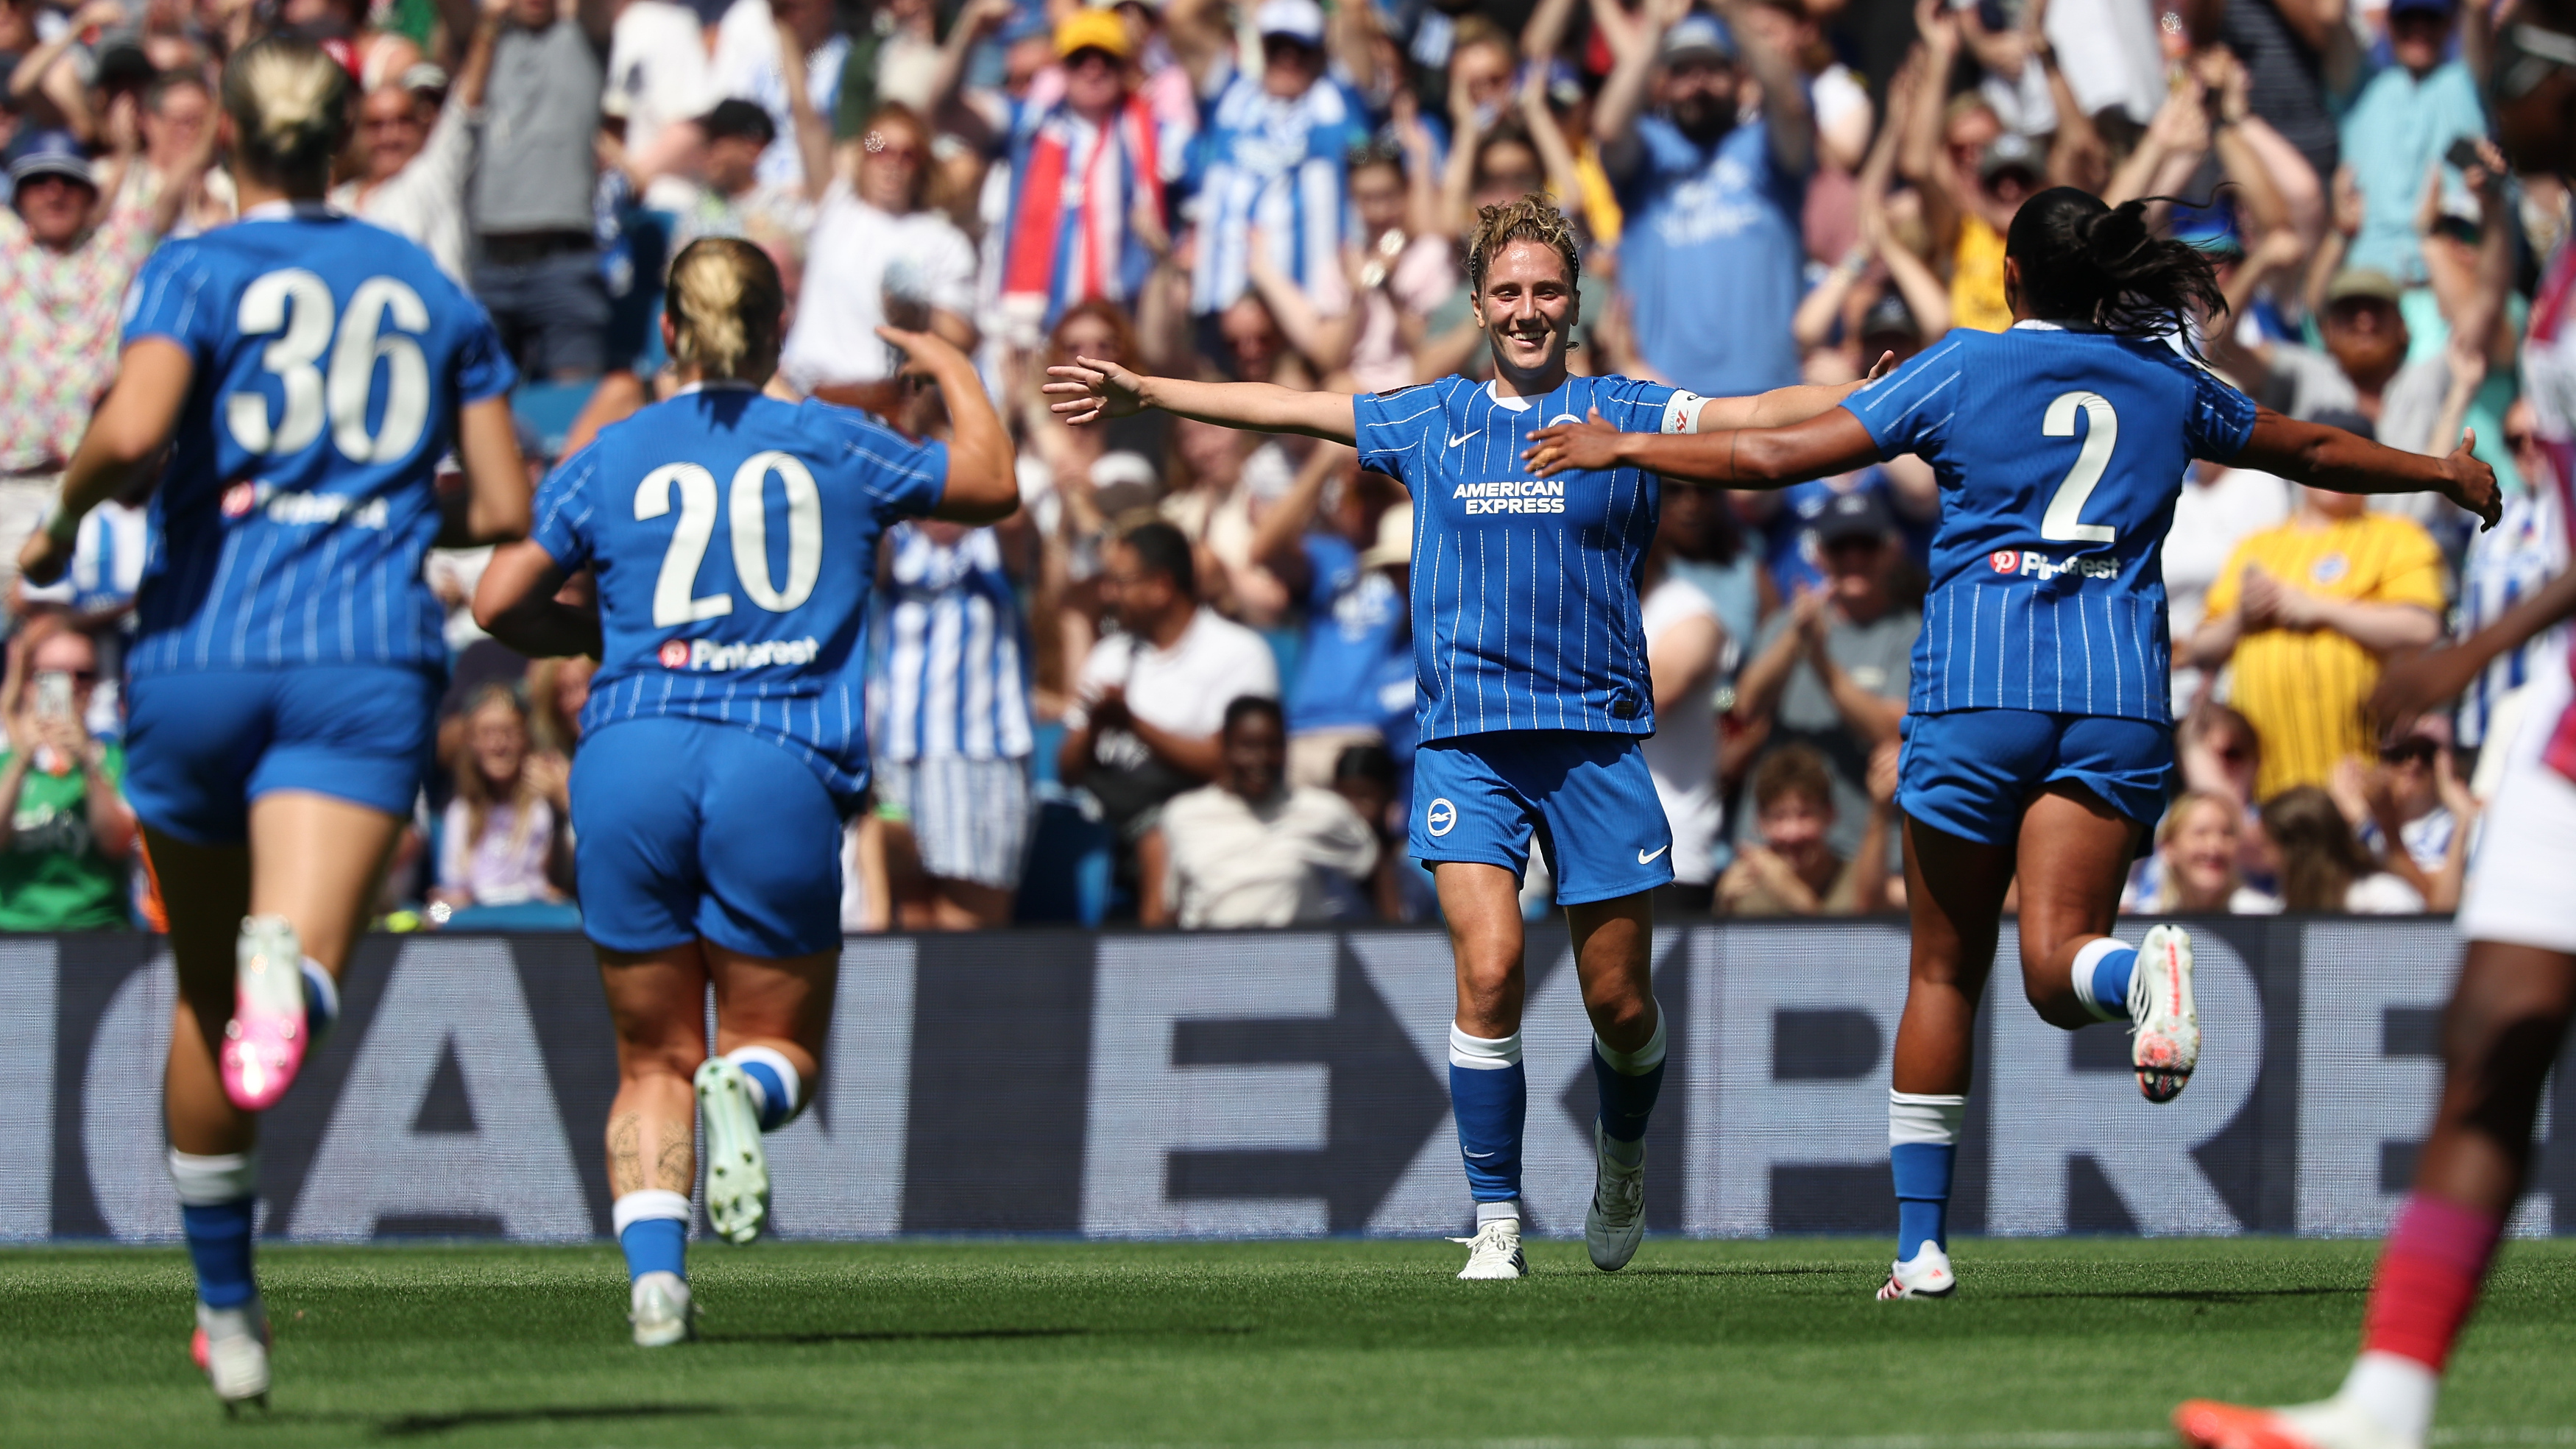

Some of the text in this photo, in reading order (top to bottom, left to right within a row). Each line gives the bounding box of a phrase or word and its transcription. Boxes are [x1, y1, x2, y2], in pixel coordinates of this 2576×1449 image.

[226, 267, 431, 466] 36
[1676, 409, 1689, 434] SL
[1453, 481, 1564, 499] AMERICAN
[1466, 498, 1565, 514] EXPRESS
[2041, 391, 2117, 542] 2
[634, 450, 823, 628] 20
